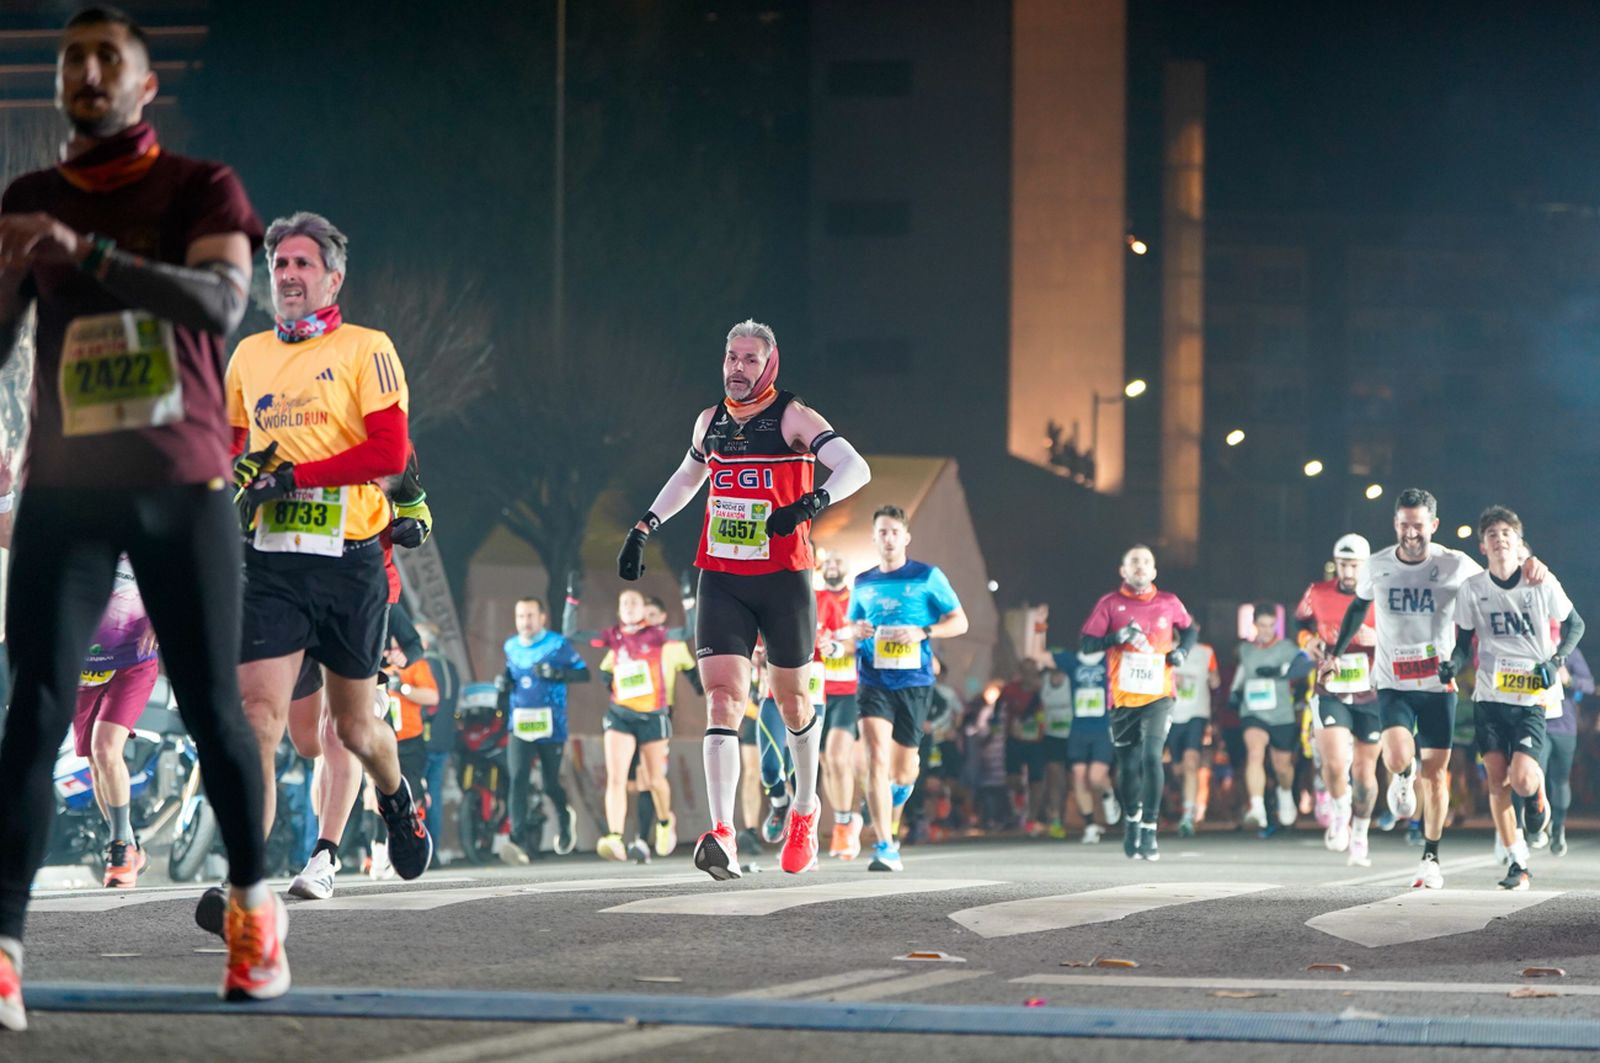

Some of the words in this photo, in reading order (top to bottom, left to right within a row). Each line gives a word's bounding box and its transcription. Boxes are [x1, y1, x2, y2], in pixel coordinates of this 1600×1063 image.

[75, 353, 152, 394] 2422
[714, 468, 773, 489] CGI
[275, 501, 328, 527] 8733
[718, 519, 758, 540] 4557
[1388, 588, 1435, 612] ENA
[1490, 611, 1536, 636] ENA
[1502, 673, 1541, 690] 12916
